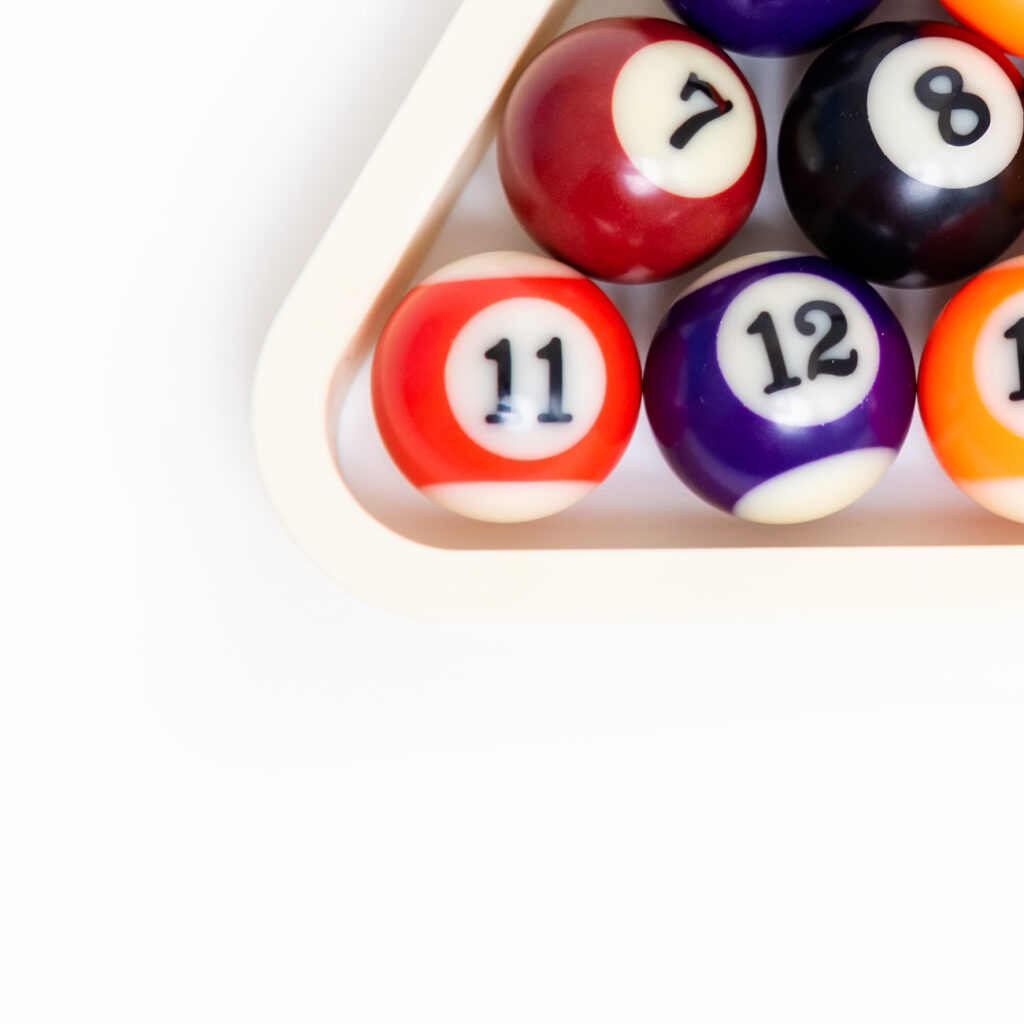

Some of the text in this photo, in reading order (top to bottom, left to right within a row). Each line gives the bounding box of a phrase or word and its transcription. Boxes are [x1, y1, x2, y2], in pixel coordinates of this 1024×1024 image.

[670, 73, 733, 149] 7
[914, 66, 991, 146] 8
[484, 337, 573, 424] 11
[746, 300, 859, 395] 12
